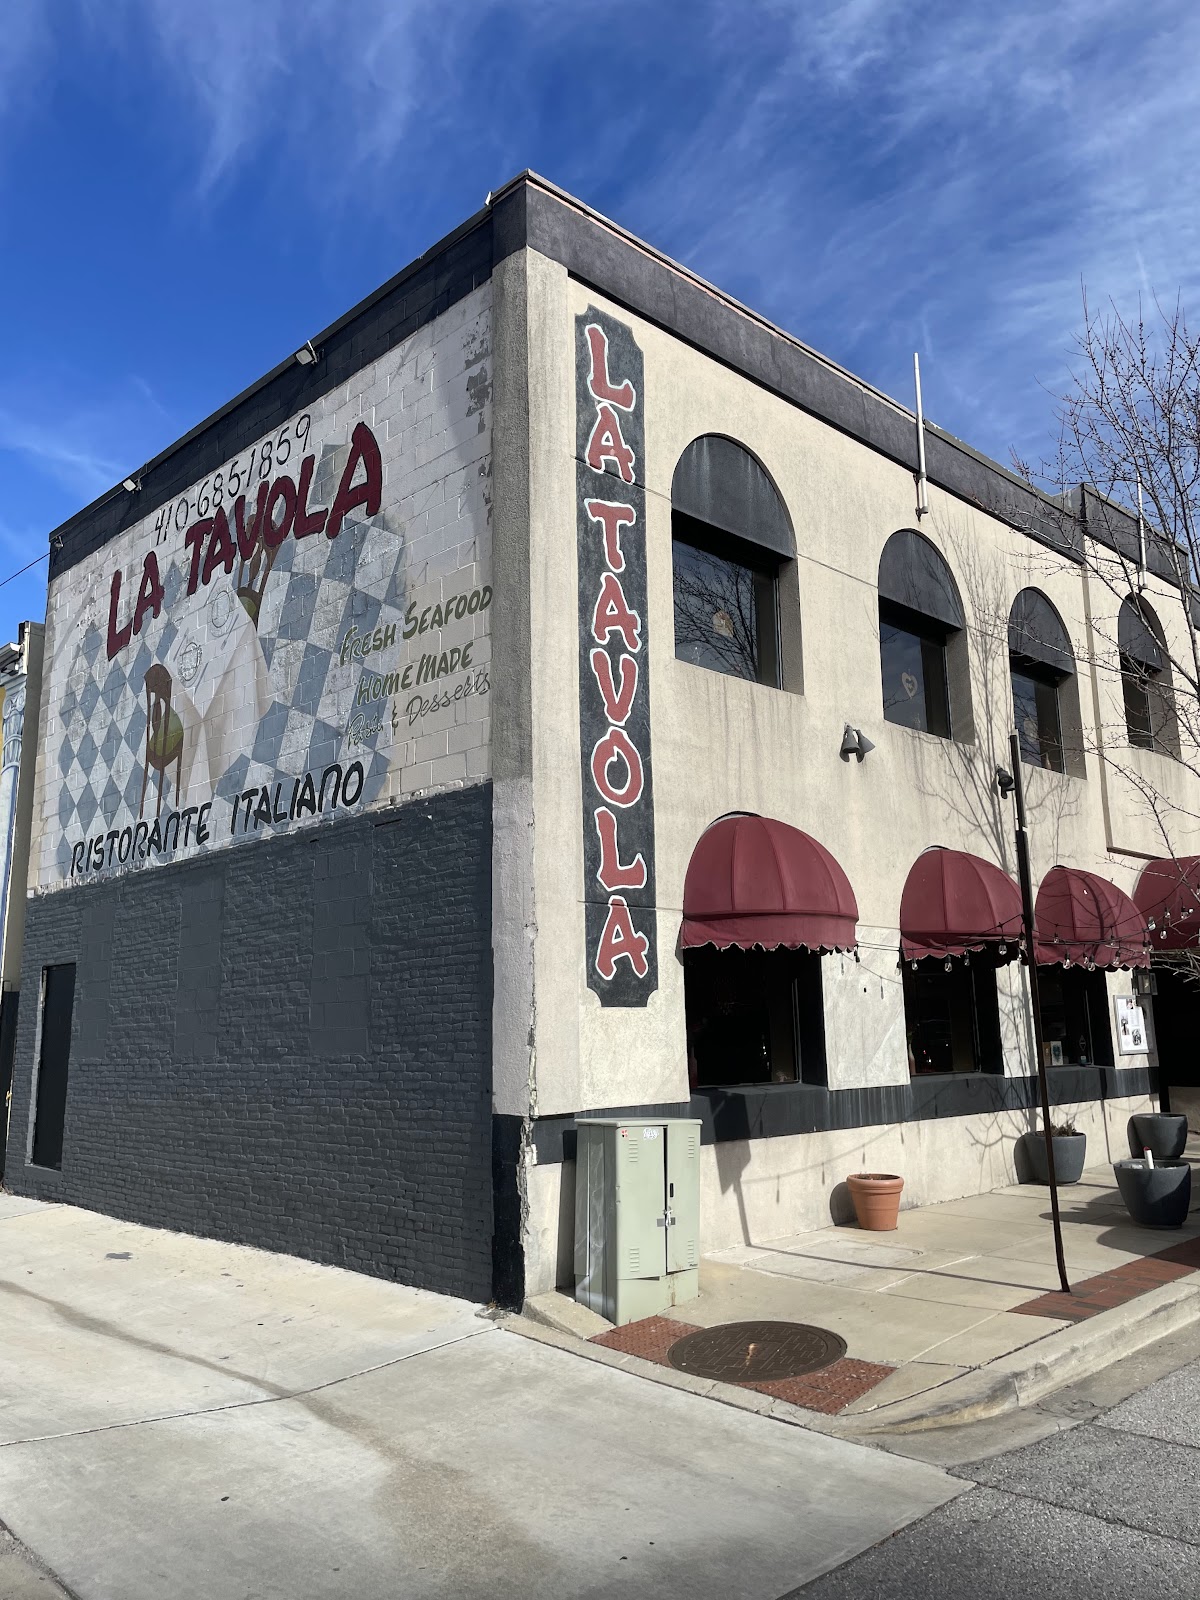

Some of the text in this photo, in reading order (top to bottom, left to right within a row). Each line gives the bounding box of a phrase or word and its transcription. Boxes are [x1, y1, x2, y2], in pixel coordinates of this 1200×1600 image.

[107, 421, 383, 661] LA TAVOLA
[155, 414, 311, 546] 410-685-1859
[340, 623, 397, 667] FRESH
[405, 670, 491, 726] Desserts
[584, 323, 649, 980] LA TAVOLA
[70, 761, 364, 877] RISTORANTE ITALIANO
